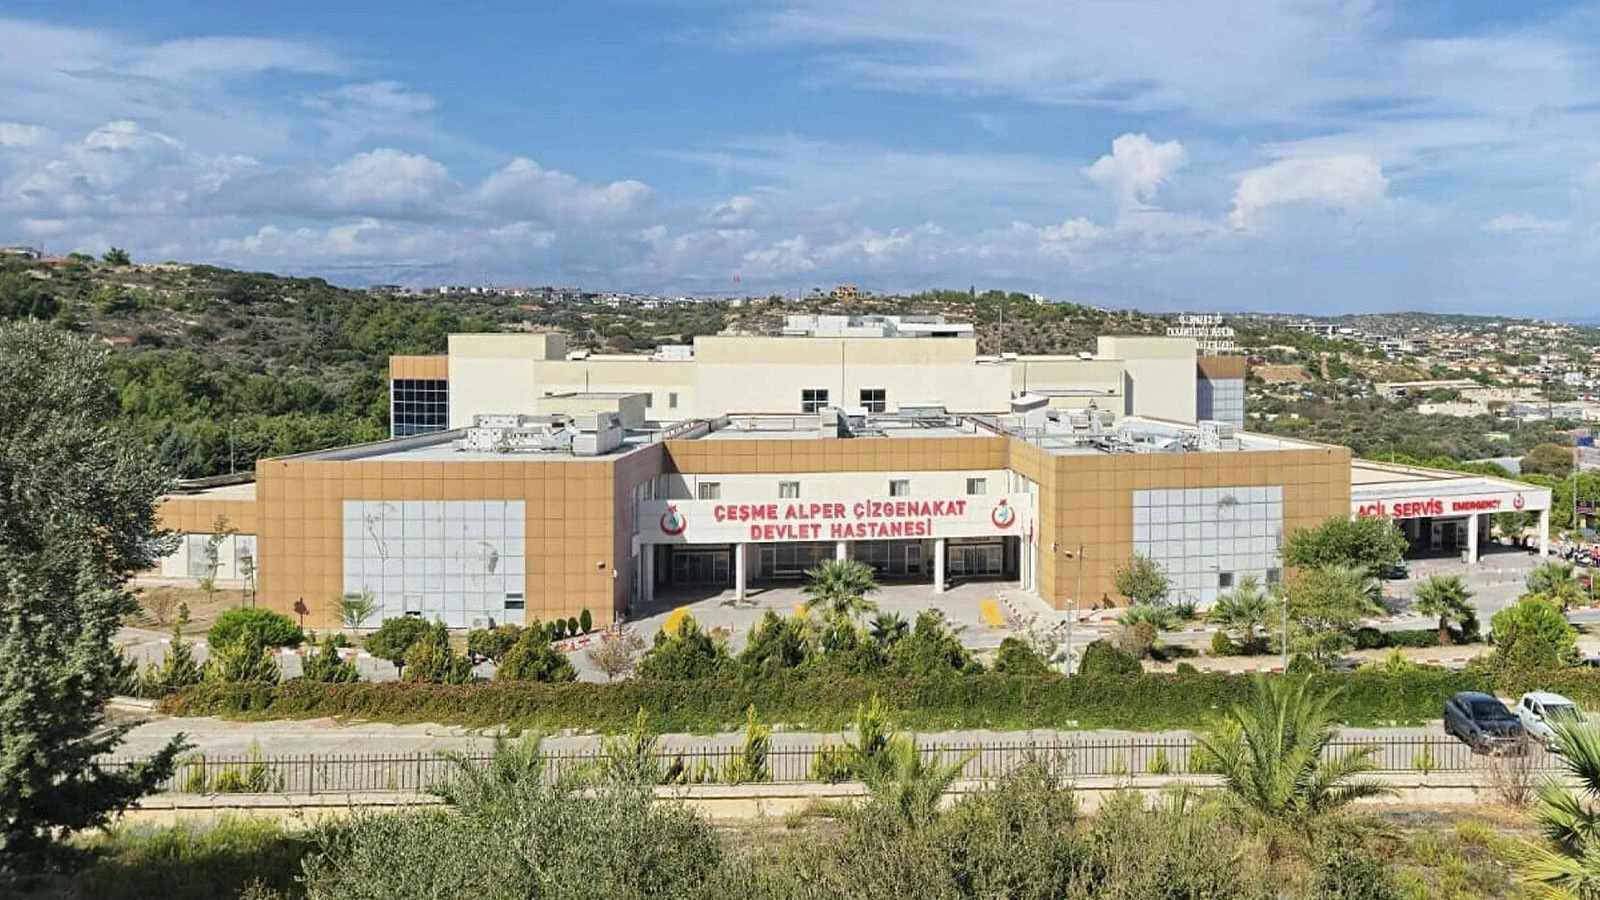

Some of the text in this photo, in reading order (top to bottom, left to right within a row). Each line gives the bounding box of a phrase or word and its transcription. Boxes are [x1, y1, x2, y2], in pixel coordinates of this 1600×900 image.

[713, 499, 967, 523] ÇEŞME ALPER ÇİZGENAKAT
[1392, 498, 1443, 517] SERVİS
[1452, 499, 1502, 512] EMERGENCY
[750, 518, 932, 540] DEVLET HASTANESİ
